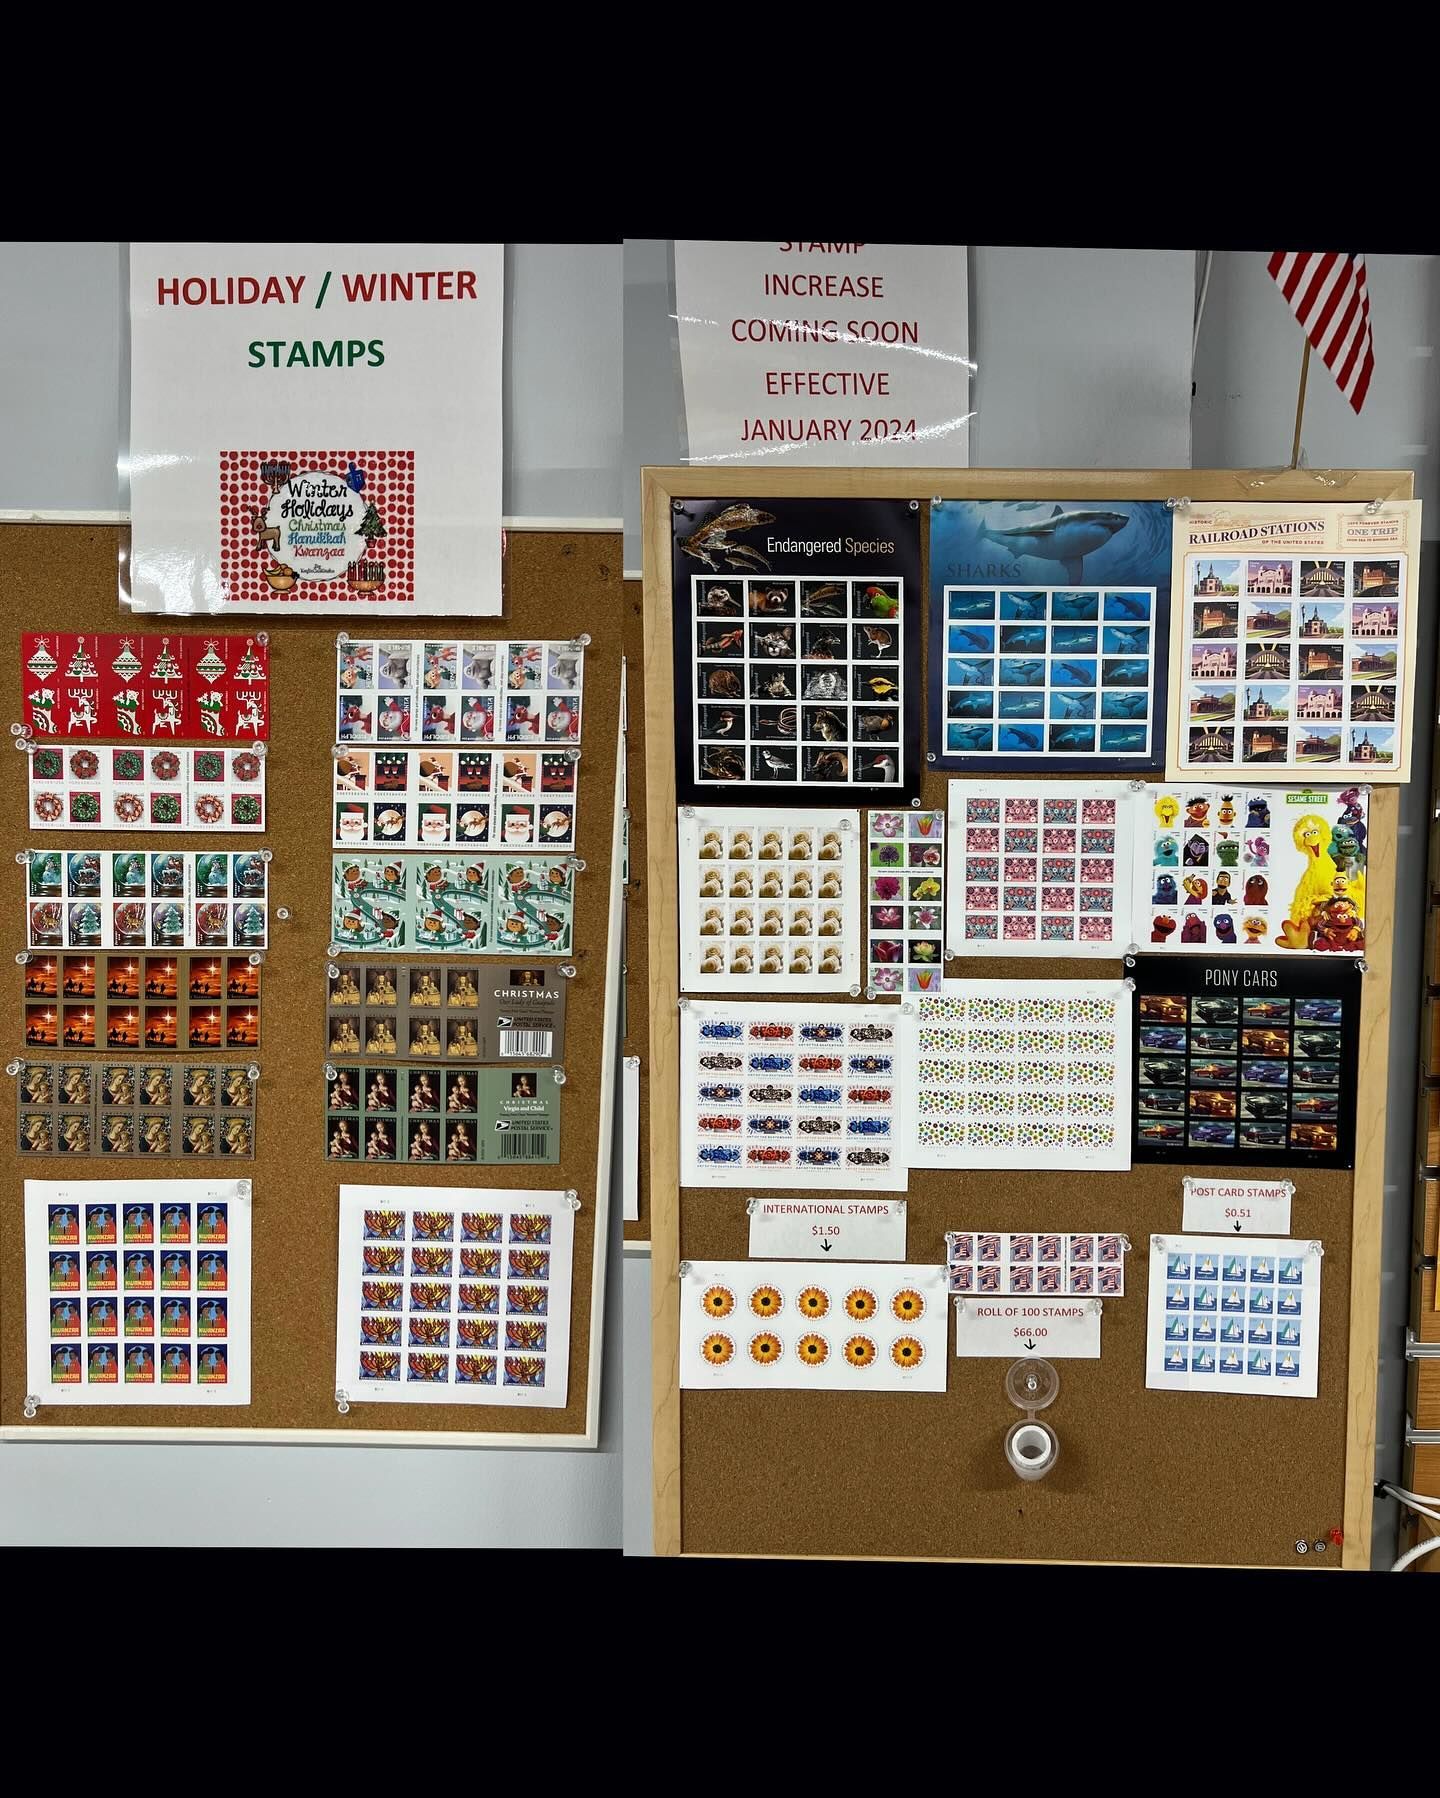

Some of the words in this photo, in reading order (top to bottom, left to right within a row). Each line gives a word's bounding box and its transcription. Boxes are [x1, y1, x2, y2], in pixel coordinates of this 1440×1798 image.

[157, 275, 307, 305] HOLIDAY
[342, 271, 478, 302] WINTER
[764, 273, 884, 298] INCREASE
[731, 319, 838, 343] COMING
[847, 320, 919, 344] SOON
[247, 339, 386, 369] STAMPS
[766, 372, 890, 396] EFFECTIVE
[741, 418, 852, 442] JANUARY
[860, 418, 917, 441] 2024
[287, 479, 348, 498] Winter
[280, 499, 354, 522] Holidays
[288, 519, 346, 532] Christmas
[1189, 527, 1258, 545] RAILROAD
[1260, 520, 1325, 537] STATIONS
[1347, 528, 1369, 536] ONE
[1371, 527, 1398, 536] TRIP
[287, 532, 346, 545] Hanukkah
[293, 545, 345, 560] Kwanzaa
[767, 537, 842, 556] Endangered
[845, 537, 895, 556] Species
[944, 563, 1021, 577] SHARKS
[1205, 968, 1239, 986] PONY
[1243, 969, 1278, 987] CARS
[494, 989, 559, 999] CHRISTMAS
[1218, 1187, 1244, 1198] CARD
[1246, 1188, 1287, 1198] STAMPS
[763, 1204, 846, 1215] INTERNATIONAL
[848, 1205, 889, 1215] STAMPS
[1224, 1207, 1251, 1219] $0.51
[811, 1225, 840, 1237] $1.50
[977, 1307, 1001, 1316] ROLL
[1005, 1307, 1019, 1316] OF
[1022, 1307, 1040, 1316] 100
[1043, 1307, 1084, 1317] STAMPS
[1013, 1327, 1048, 1338] $66.00
